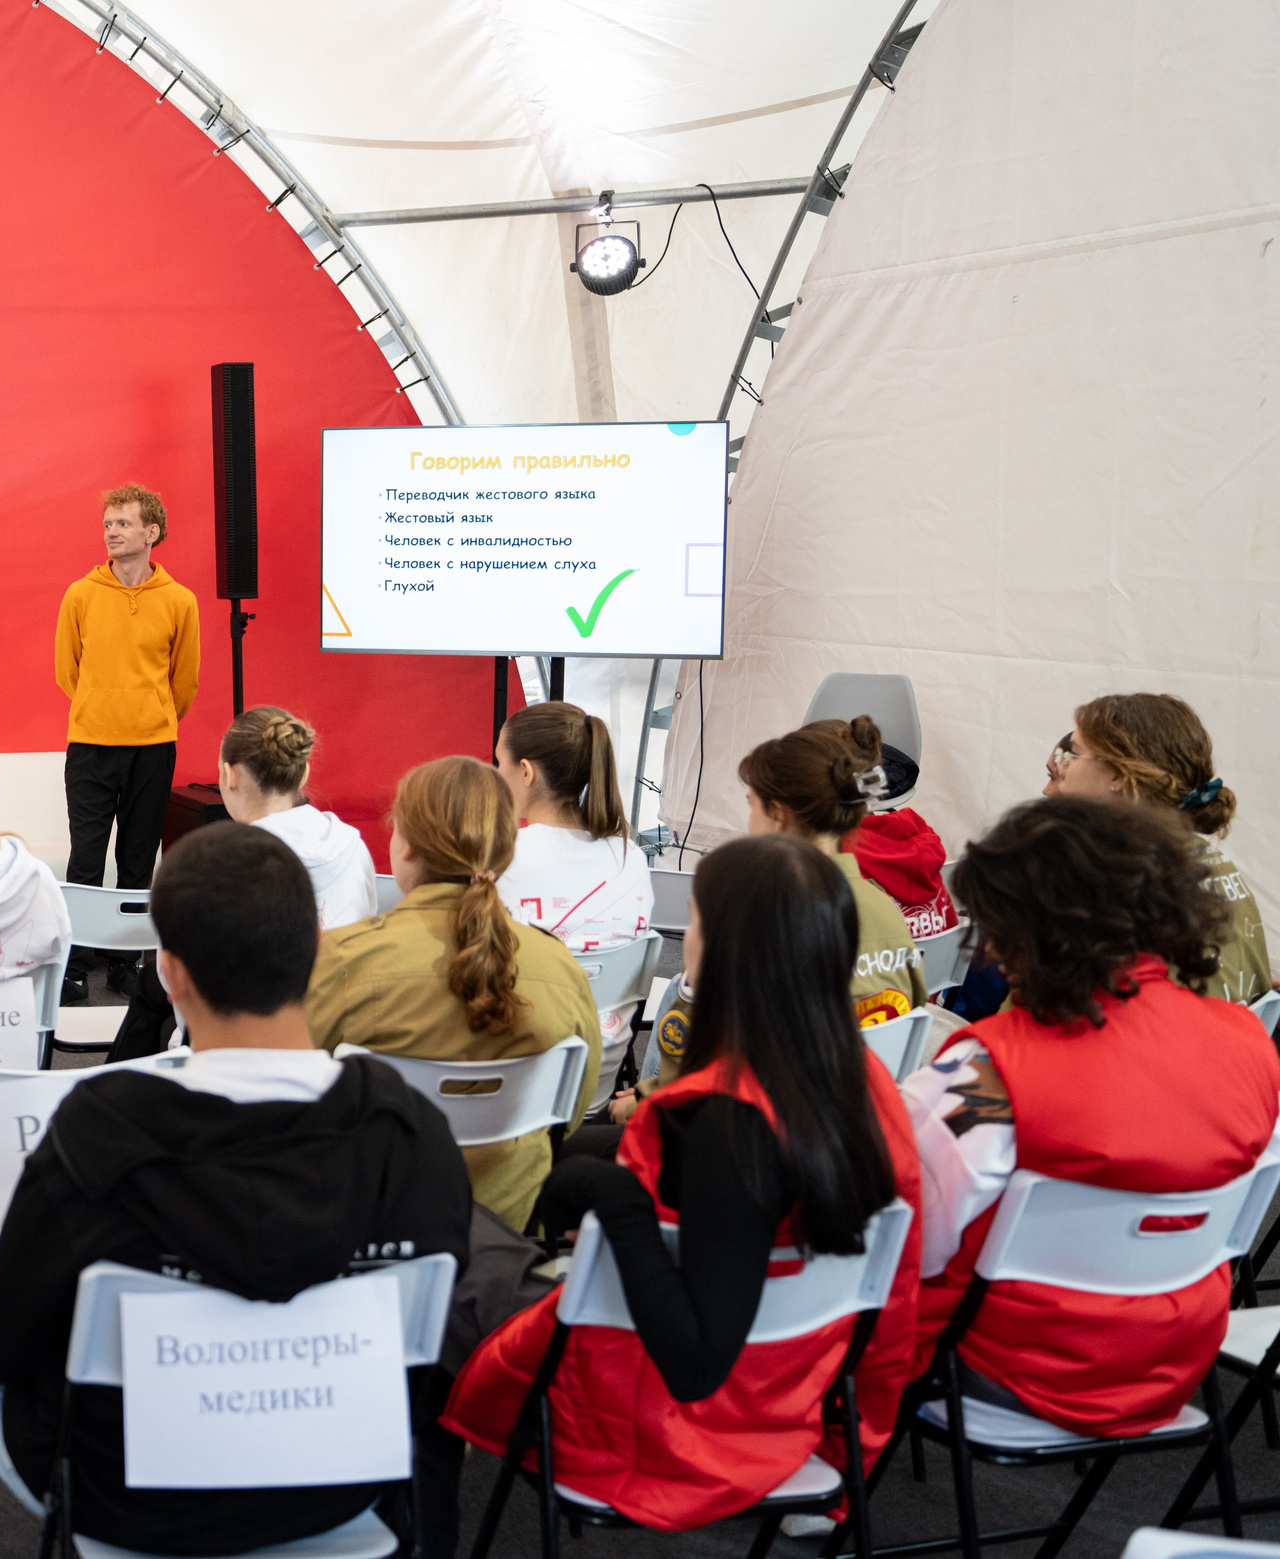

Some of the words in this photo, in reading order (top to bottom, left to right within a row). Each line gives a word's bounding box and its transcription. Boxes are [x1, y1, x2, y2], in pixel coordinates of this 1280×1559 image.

[410, 451, 502, 475] Говорим
[512, 451, 631, 475] правильно
[385, 488, 470, 504] Переводчик
[475, 489, 548, 500] жестового
[554, 489, 596, 500] языка
[385, 511, 455, 524] Жестовый
[461, 514, 494, 523] язык
[385, 534, 441, 547] Человек
[446, 537, 455, 547] с
[460, 535, 573, 548] инвалидностью
[384, 557, 441, 569] Человек
[446, 560, 455, 569] с
[460, 559, 548, 573] нарушением
[553, 560, 597, 573] слуха
[384, 579, 435, 595] Глухой
[154, 1329, 374, 1368] Волонтеры-
[199, 1385, 335, 1416] медики
